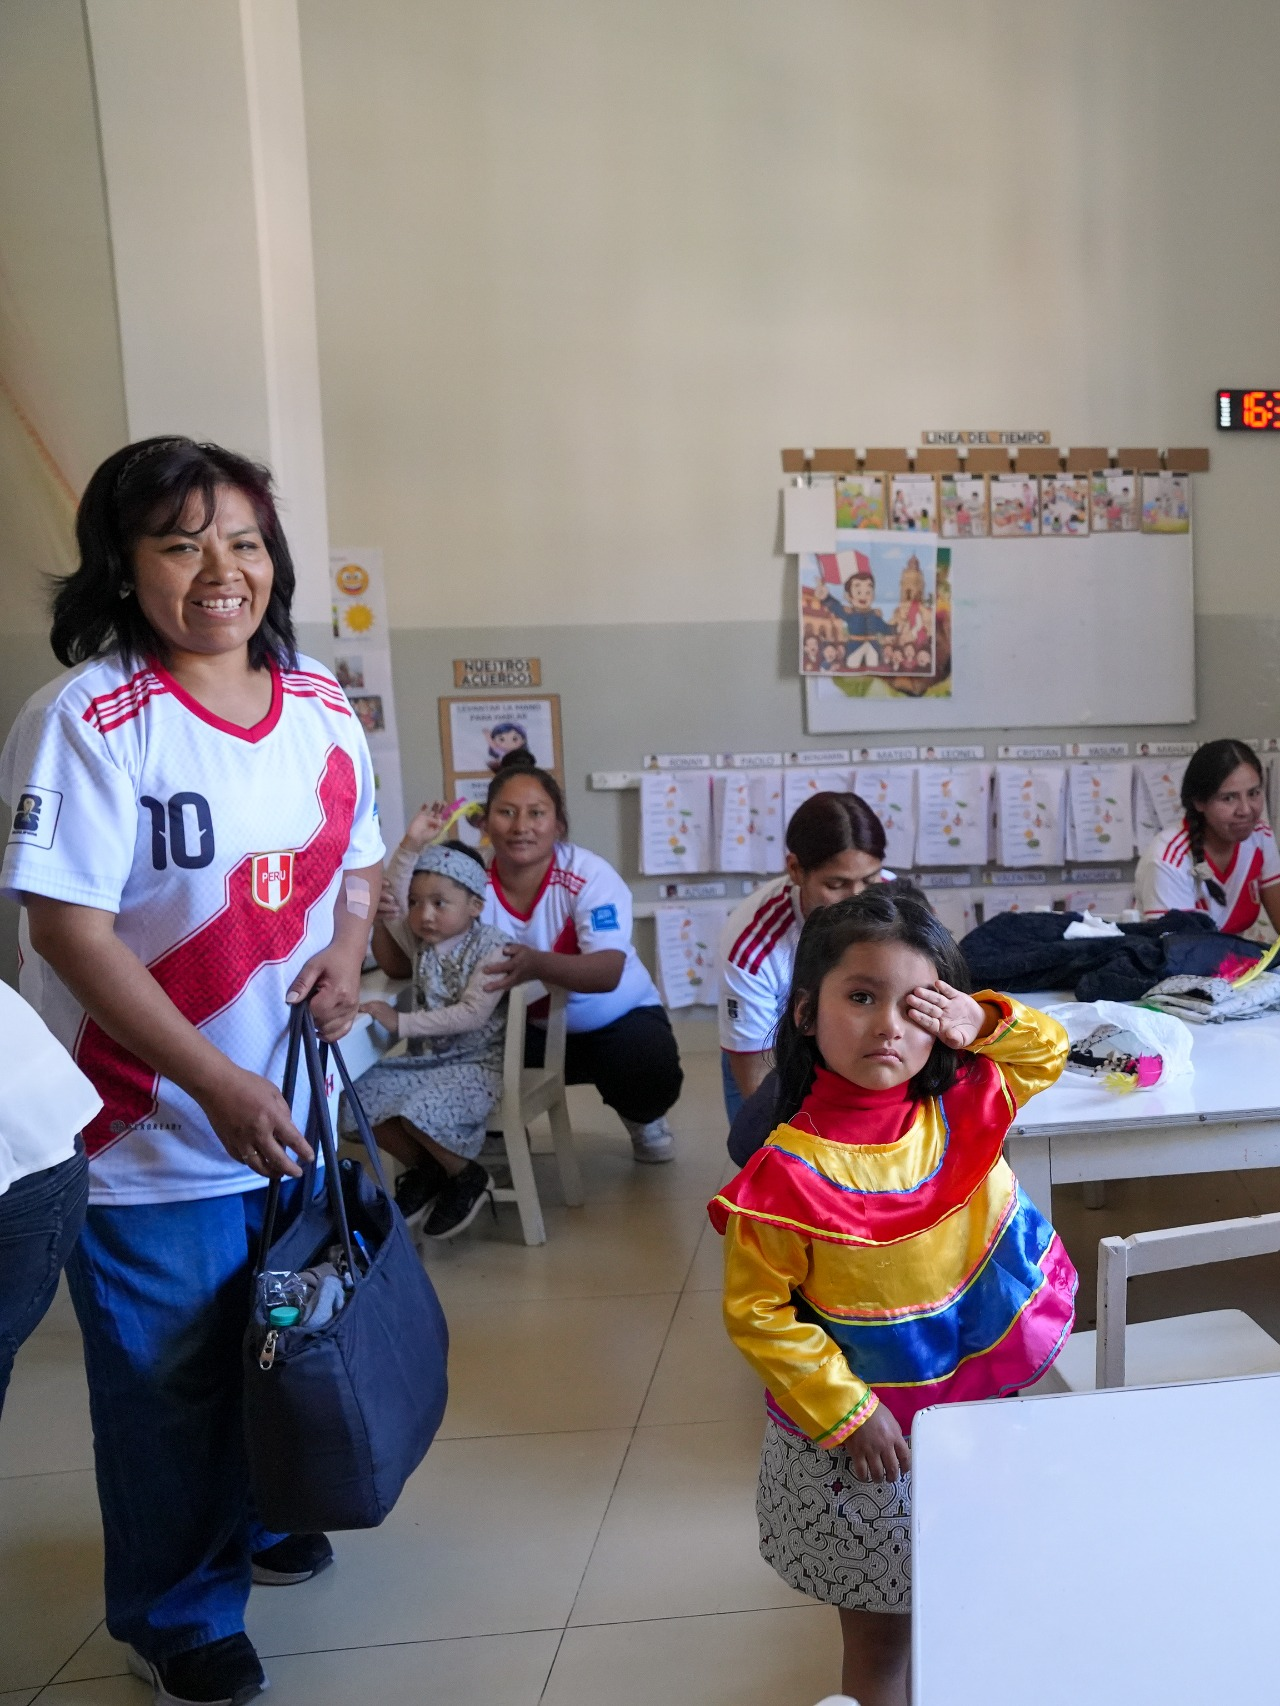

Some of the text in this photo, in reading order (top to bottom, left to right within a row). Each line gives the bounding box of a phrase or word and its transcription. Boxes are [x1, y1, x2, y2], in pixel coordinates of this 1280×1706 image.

[969, 432, 990, 444] DEL
[1000, 431, 1045, 444] TIEMPO
[464, 659, 531, 672] NUESTROS
[462, 673, 533, 687] ACUERDOS
[876, 750, 912, 759] MATEO
[140, 791, 215, 871] 10
[262, 870, 286, 883] PERU
